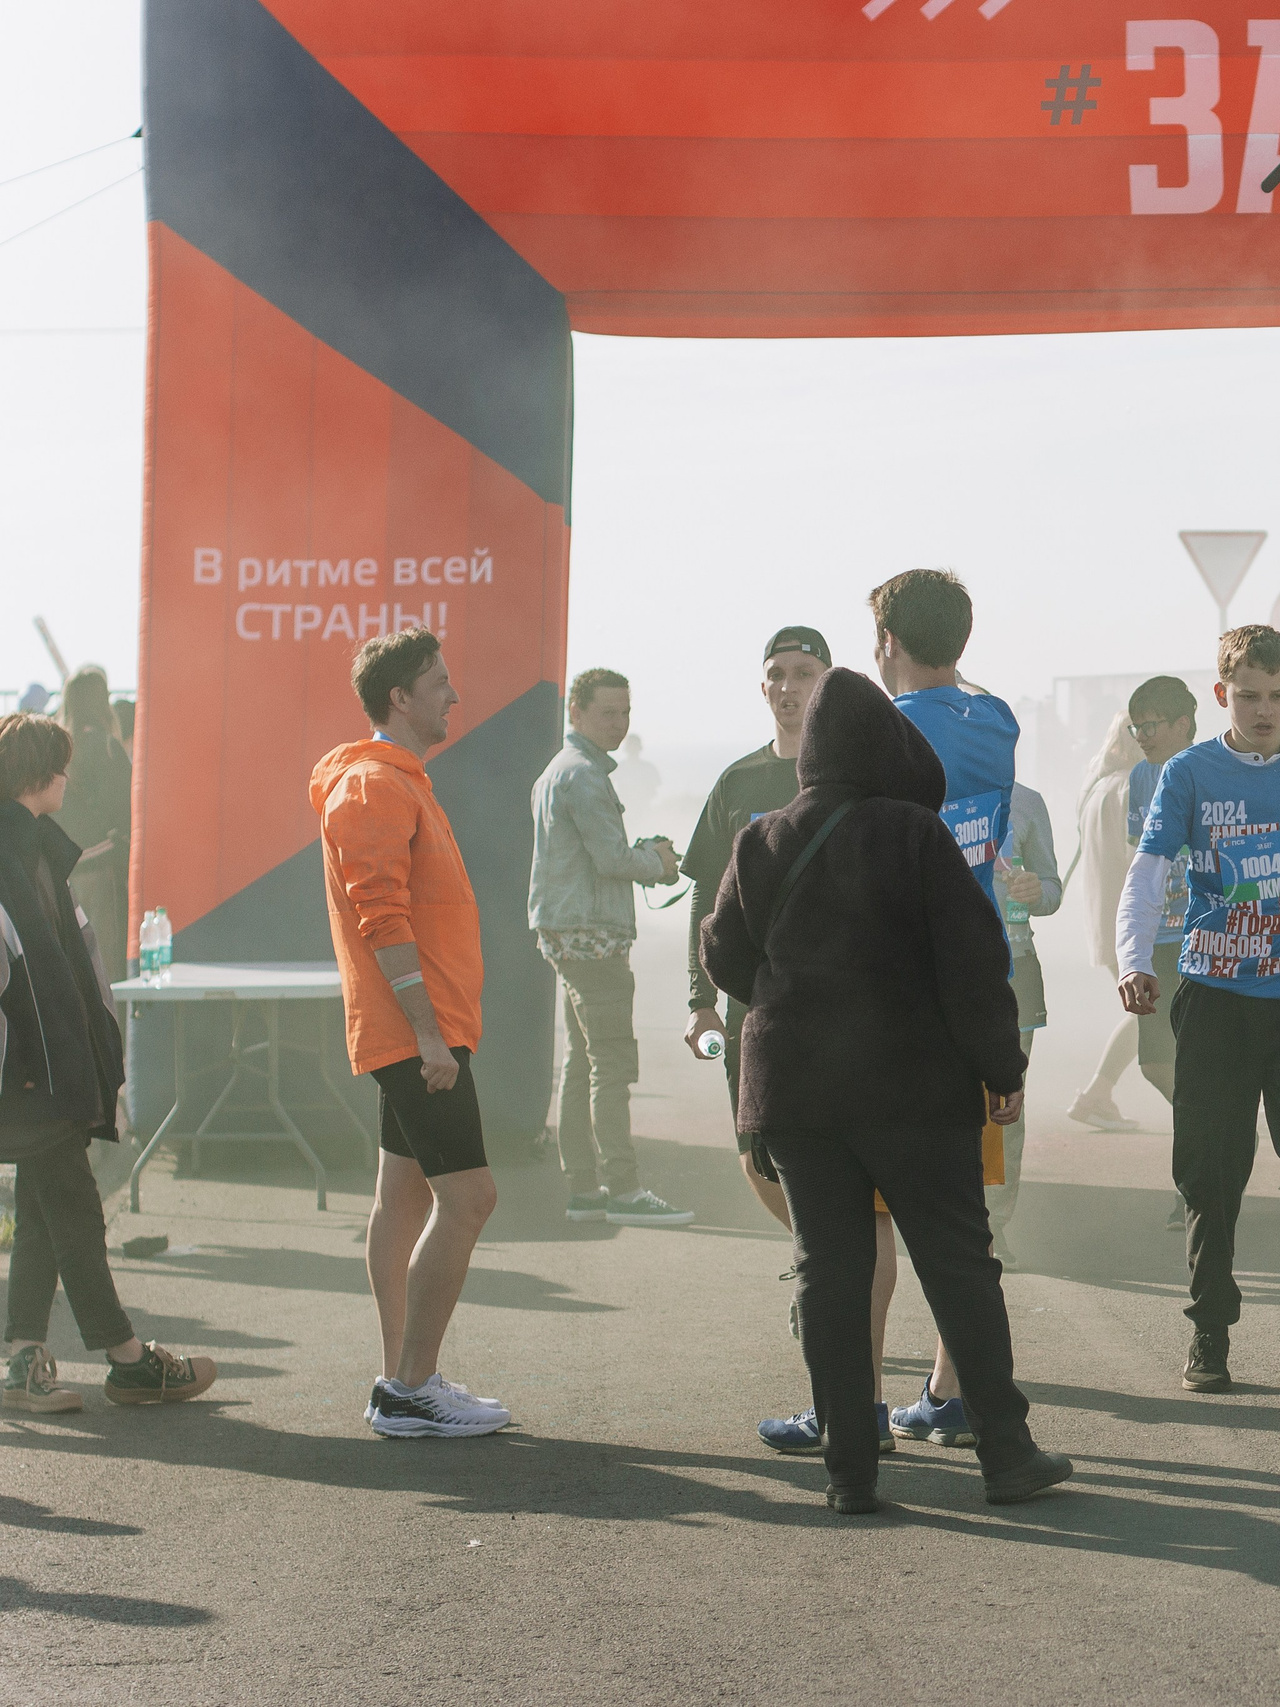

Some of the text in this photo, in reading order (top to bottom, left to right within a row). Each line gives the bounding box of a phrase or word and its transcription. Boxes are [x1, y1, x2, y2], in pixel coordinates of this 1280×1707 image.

[193, 547, 494, 592] В ритме всей
[235, 601, 449, 641] СТРАНЫ!
[1200, 799, 1248, 826] 2024
[954, 816, 990, 847] 30013
[1188, 928, 1273, 958] #ЛЮБОВЬ
